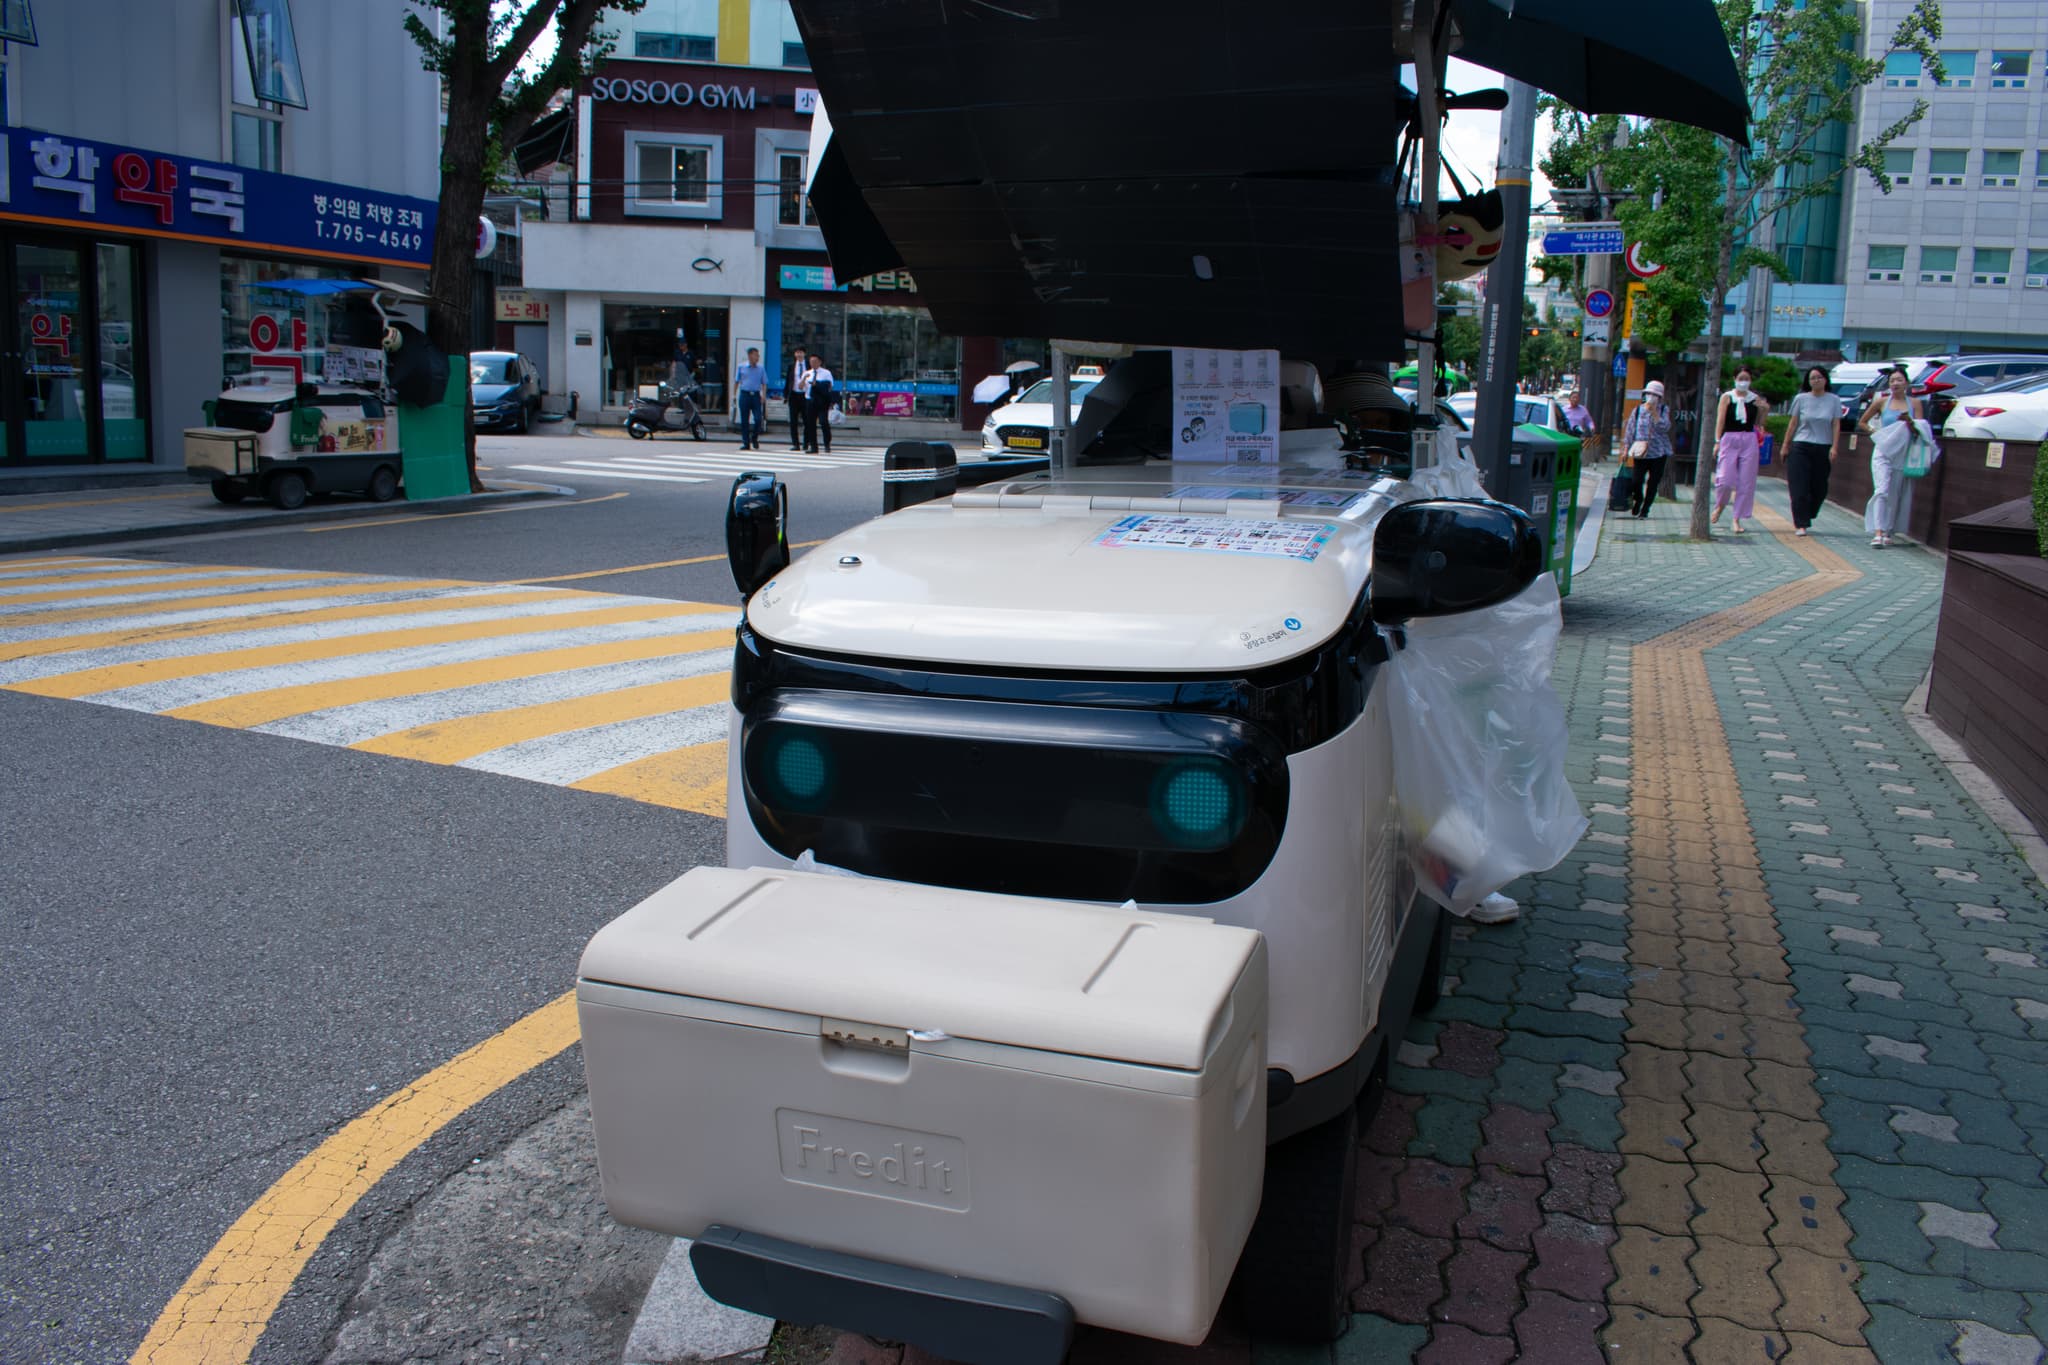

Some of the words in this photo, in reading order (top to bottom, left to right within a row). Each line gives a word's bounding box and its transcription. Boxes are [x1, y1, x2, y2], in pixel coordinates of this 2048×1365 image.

[592, 77, 694, 106] SOSOO
[700, 83, 755, 110] GYM
[314, 194, 361, 219] 병·의원
[366, 202, 393, 224] 처방
[397, 208, 423, 229] 조제
[31, 313, 72, 358] 약
[249, 313, 308, 385] 약
[793, 1124, 953, 1194] Fredit
